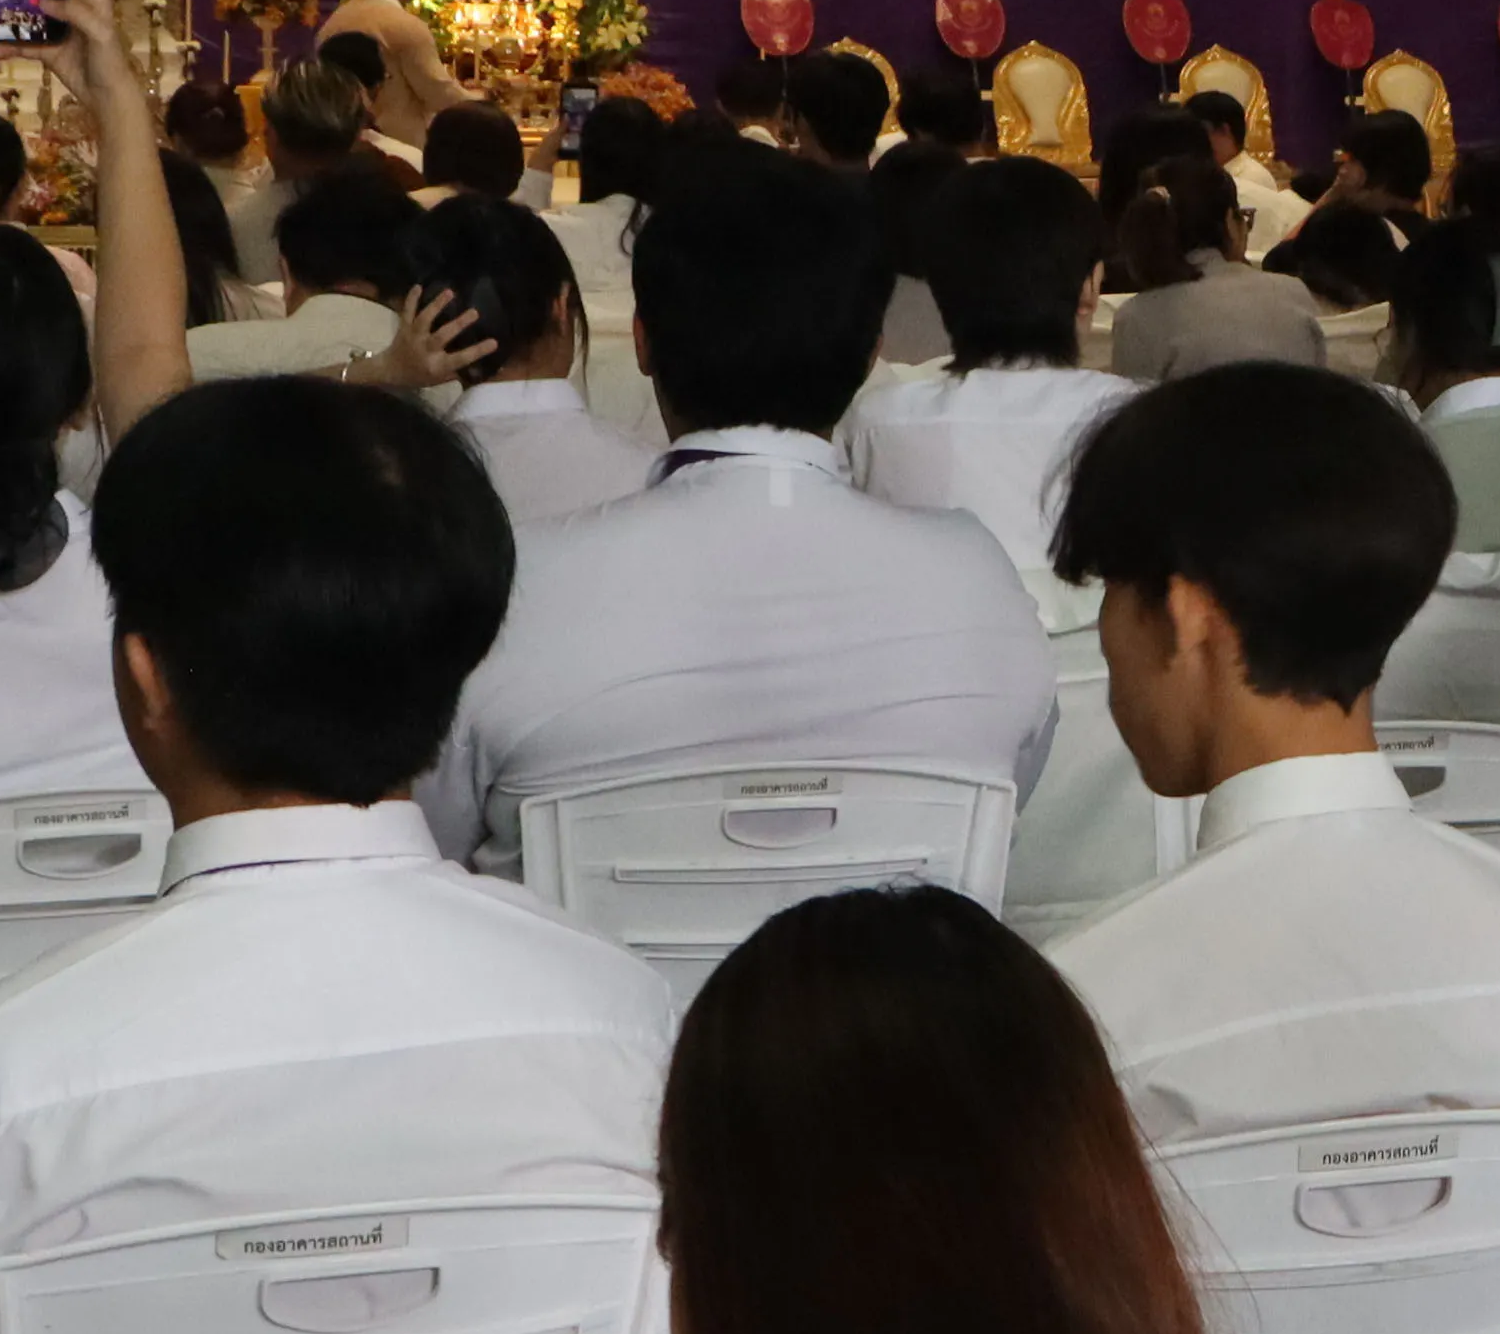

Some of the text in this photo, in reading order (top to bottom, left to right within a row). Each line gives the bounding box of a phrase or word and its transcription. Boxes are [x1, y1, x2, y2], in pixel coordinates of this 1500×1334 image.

[1321, 1134, 1440, 1166] กองอาคารสถานที่
[242, 1221, 384, 1255] กองอาคารสถานที่
